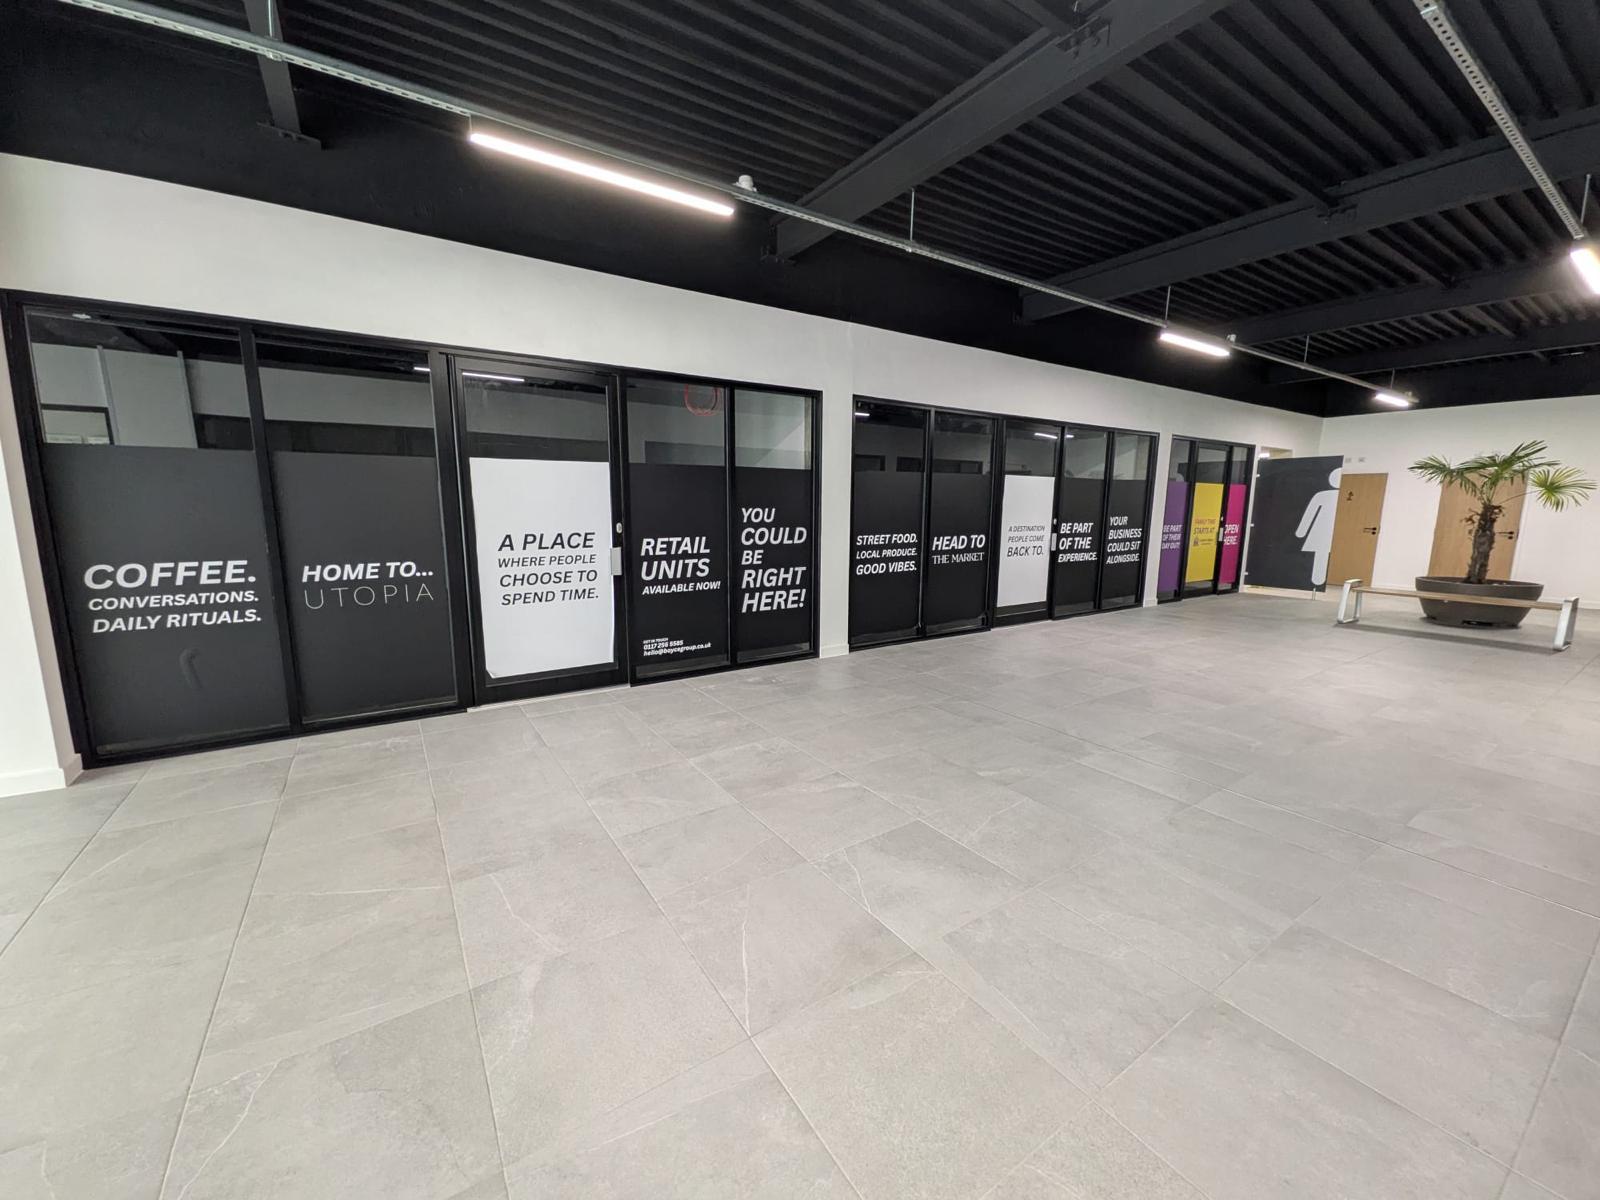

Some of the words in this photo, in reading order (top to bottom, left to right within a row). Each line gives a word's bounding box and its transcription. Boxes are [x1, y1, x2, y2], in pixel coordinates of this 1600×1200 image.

[741, 507, 775, 523] YOU
[1110, 517, 1128, 525] YOUR
[1014, 524, 1045, 532] DESTINATION
[1060, 523, 1072, 534] BE
[1073, 522, 1093, 533] PART
[1108, 528, 1142, 539] BUSINESS
[1170, 524, 1182, 532] PART
[498, 533, 515, 552] A
[522, 532, 596, 550] PLACE
[740, 527, 807, 547] COULD
[856, 535, 890, 546] STREET
[892, 533, 918, 544] FOOD.
[932, 536, 967, 550] HEAD
[970, 535, 985, 548] TO
[1008, 535, 1028, 543] PEOPLE
[1029, 534, 1044, 542] COME
[1059, 538, 1072, 550] OF
[1073, 537, 1091, 549] THE
[640, 536, 710, 557] RETAIL
[1007, 546, 1028, 557] BACK
[1030, 545, 1044, 556] TO.
[1107, 542, 1130, 552] COULD
[1131, 540, 1140, 550] SIT
[741, 549, 764, 566] BE
[856, 549, 881, 559] LOCAL
[882, 548, 917, 557] PRODUCE.
[932, 554, 950, 565] THE
[951, 552, 984, 563] MARKET
[1057, 552, 1098, 563] EXPERIENCE.
[498, 556, 546, 568] WHERE
[549, 554, 597, 566] PEOPLE
[856, 563, 885, 575] GOOD
[889, 561, 917, 573] VIBES.
[83, 559, 257, 590] COFFEE.
[301, 563, 379, 583] HOME
[385, 561, 434, 579] TO...
[640, 558, 710, 581] UNITS
[499, 572, 572, 587] CHOOSE
[577, 569, 598, 583] TO
[741, 567, 807, 589] RIGHT
[641, 582, 694, 595] AVAILABLE
[696, 581, 721, 591] NOW!
[88, 590, 260, 611] CONVERSATIONS.
[304, 583, 434, 610] UTOPIA
[501, 590, 556, 606] SPEND
[560, 587, 599, 602] TIME.
[741, 590, 805, 614] HERE!
[92, 615, 162, 633] DAILY
[166, 608, 262, 629] RITUALS.
[643, 642, 711, 656] hello@boycegroup.co.uk
